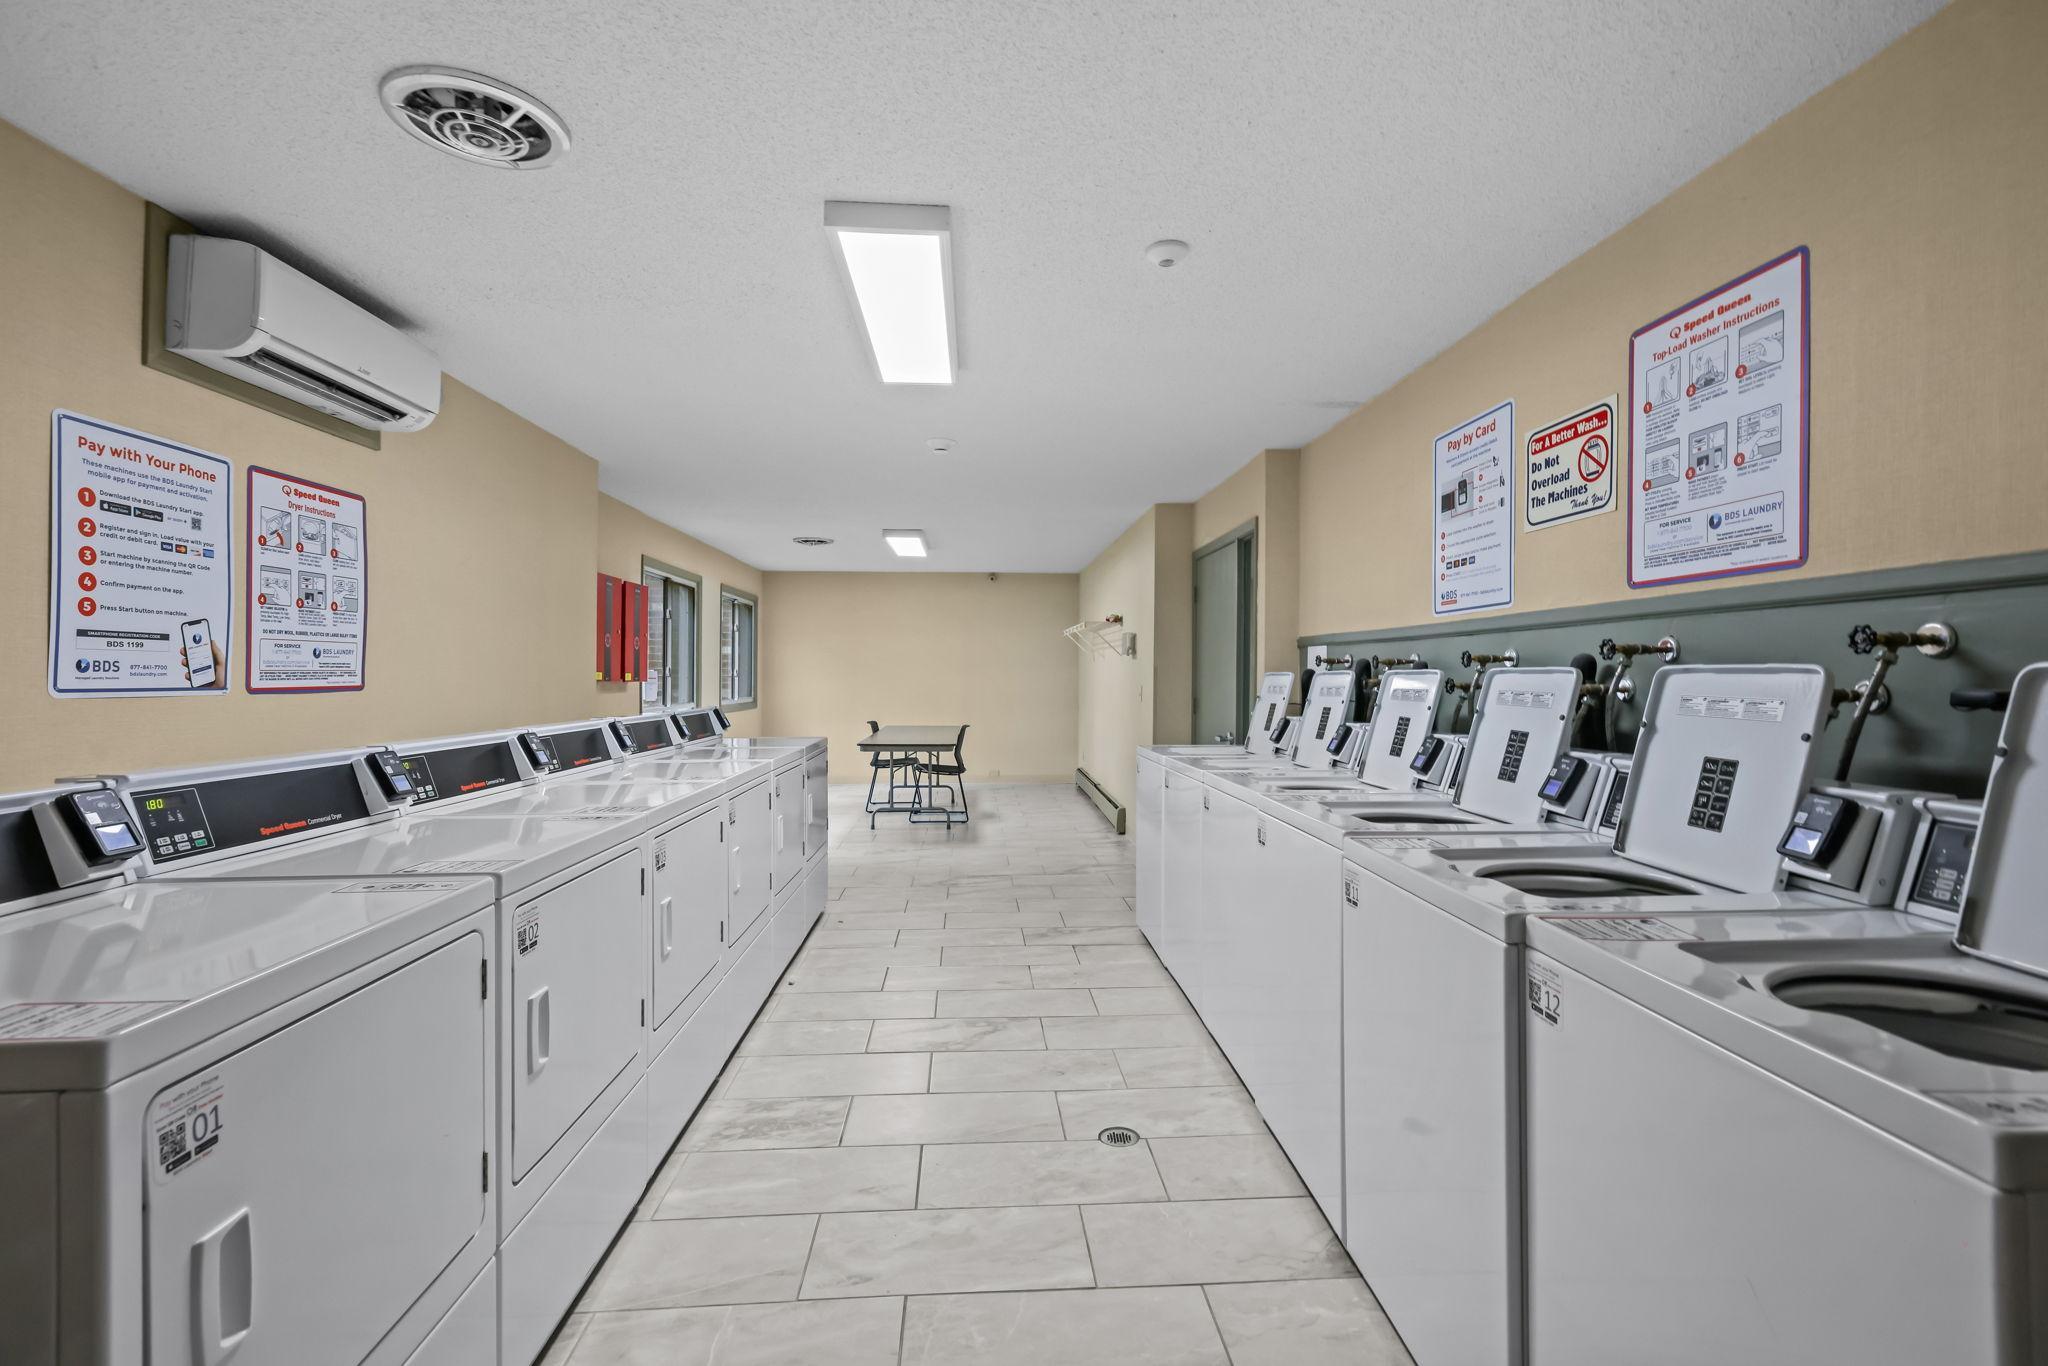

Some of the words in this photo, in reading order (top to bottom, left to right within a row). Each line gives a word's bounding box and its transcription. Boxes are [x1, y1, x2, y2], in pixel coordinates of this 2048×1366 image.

[1684, 310, 1714, 332] Speed
[1718, 294, 1751, 315] Queen
[1653, 339, 1687, 362] Top-Load
[1690, 324, 1720, 345] Washer
[1723, 298, 1780, 328] Instructions
[1448, 438, 1461, 452] Pay
[1464, 431, 1473, 445] by
[1476, 418, 1496, 438] Card
[1532, 441, 1543, 453] For
[1545, 436, 1550, 448] A
[1552, 428, 1575, 443] Better
[1577, 418, 1607, 434] Wash...
[78, 436, 105, 456] Pay
[110, 446, 141, 463] with
[146, 454, 175, 471] Your
[180, 463, 216, 482] Phone
[1532, 462, 1542, 474] Do
[1545, 455, 1559, 467] Not
[82, 458, 102, 468] These
[104, 464, 136, 476] machines
[176, 480, 198, 492] Laundry
[199, 486, 212, 495] Start
[88, 469, 111, 480] mobile
[113, 476, 125, 484] app
[138, 482, 165, 493] payment
[1532, 468, 1570, 491] Overload
[83, 492, 89, 502] 1
[100, 490, 130, 501] Download
[156, 502, 178, 512] Laundry
[180, 506, 192, 515] Start
[293, 488, 316, 501] Speed
[318, 494, 340, 507] Queen
[1531, 496, 1545, 508] The
[1548, 484, 1588, 504] Machines
[1570, 497, 1589, 509] Thank
[1591, 491, 1607, 504] You!
[288, 501, 303, 512] Dryer
[304, 504, 336, 518] Instructions
[1724, 512, 1740, 521] BDS
[1743, 501, 1782, 518] LAUNDRY
[83, 522, 91, 532] 2
[1659, 520, 1670, 528] FOR
[1670, 517, 1691, 526] SERVICE
[100, 523, 124, 534] Register
[126, 528, 138, 536] and
[140, 531, 151, 539] sign
[161, 534, 174, 542] Load
[127, 536, 142, 544] debit
[84, 550, 91, 560] 3
[100, 550, 115, 559] Start
[117, 553, 142, 562] machine
[144, 556, 151, 564] by
[152, 558, 176, 568] scanning
[108, 560, 134, 569] entering
[146, 565, 170, 573] machine
[83, 578, 92, 586] 4
[100, 580, 125, 588] Confirm
[127, 583, 152, 592] payment
[1446, 590, 1457, 600] BDS
[83, 602, 91, 611] 5
[135, 607, 154, 615] button
[92, 660, 120, 672] BDS
[260, 824, 284, 835] Speed
[284, 820, 307, 828] Queen
[307, 815, 331, 825] Commercial
[528, 922, 539, 941] 02
[1545, 990, 1560, 1017] 12
[192, 1105, 223, 1142] 01
